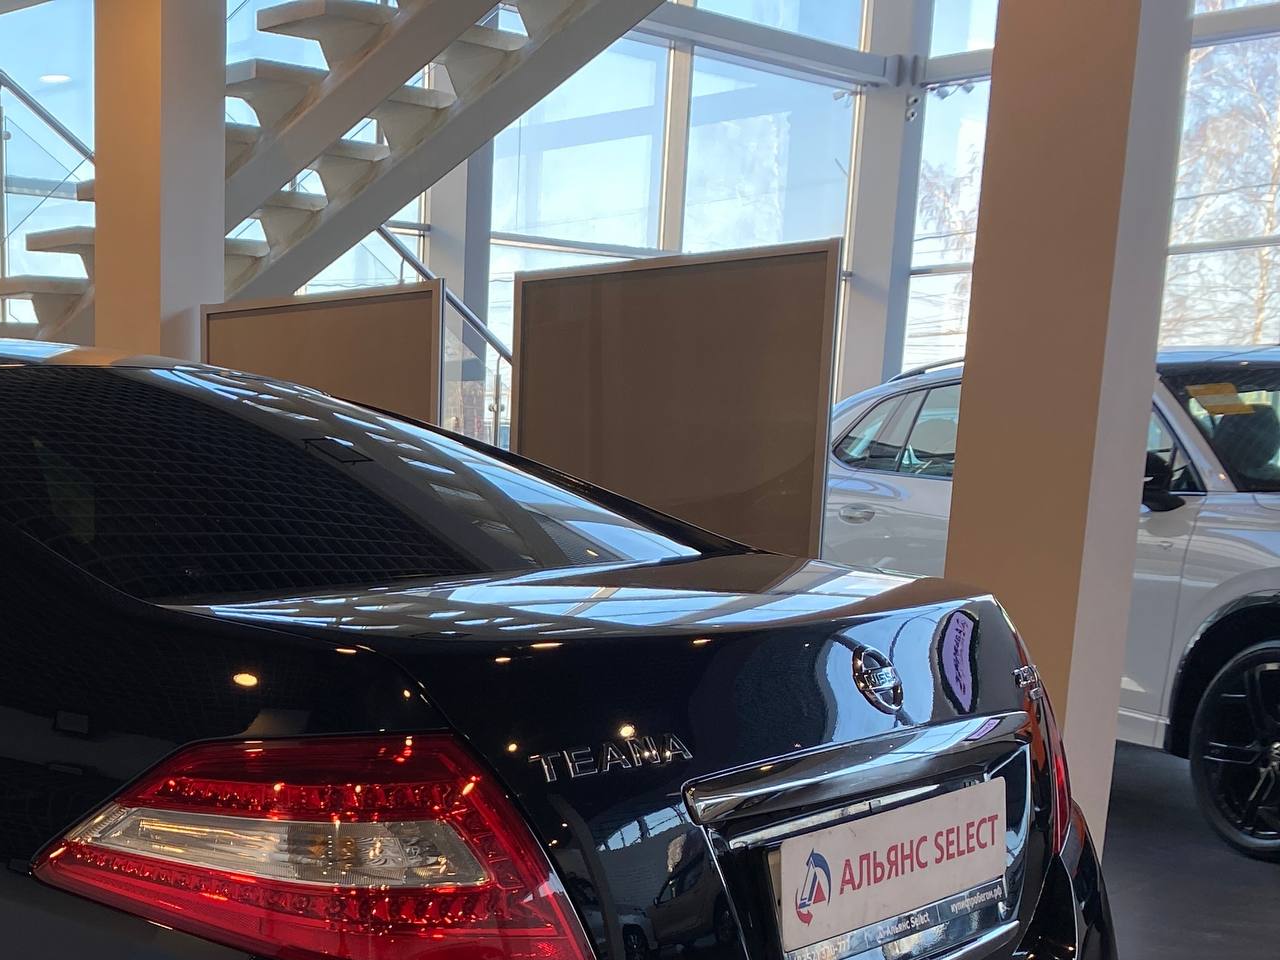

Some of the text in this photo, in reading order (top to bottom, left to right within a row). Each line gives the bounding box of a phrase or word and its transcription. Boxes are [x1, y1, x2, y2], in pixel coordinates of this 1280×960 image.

[863, 671, 897, 687] NISS
[527, 734, 693, 783] TEANA
[839, 814, 999, 895] АЛЬЯНС SELECT
